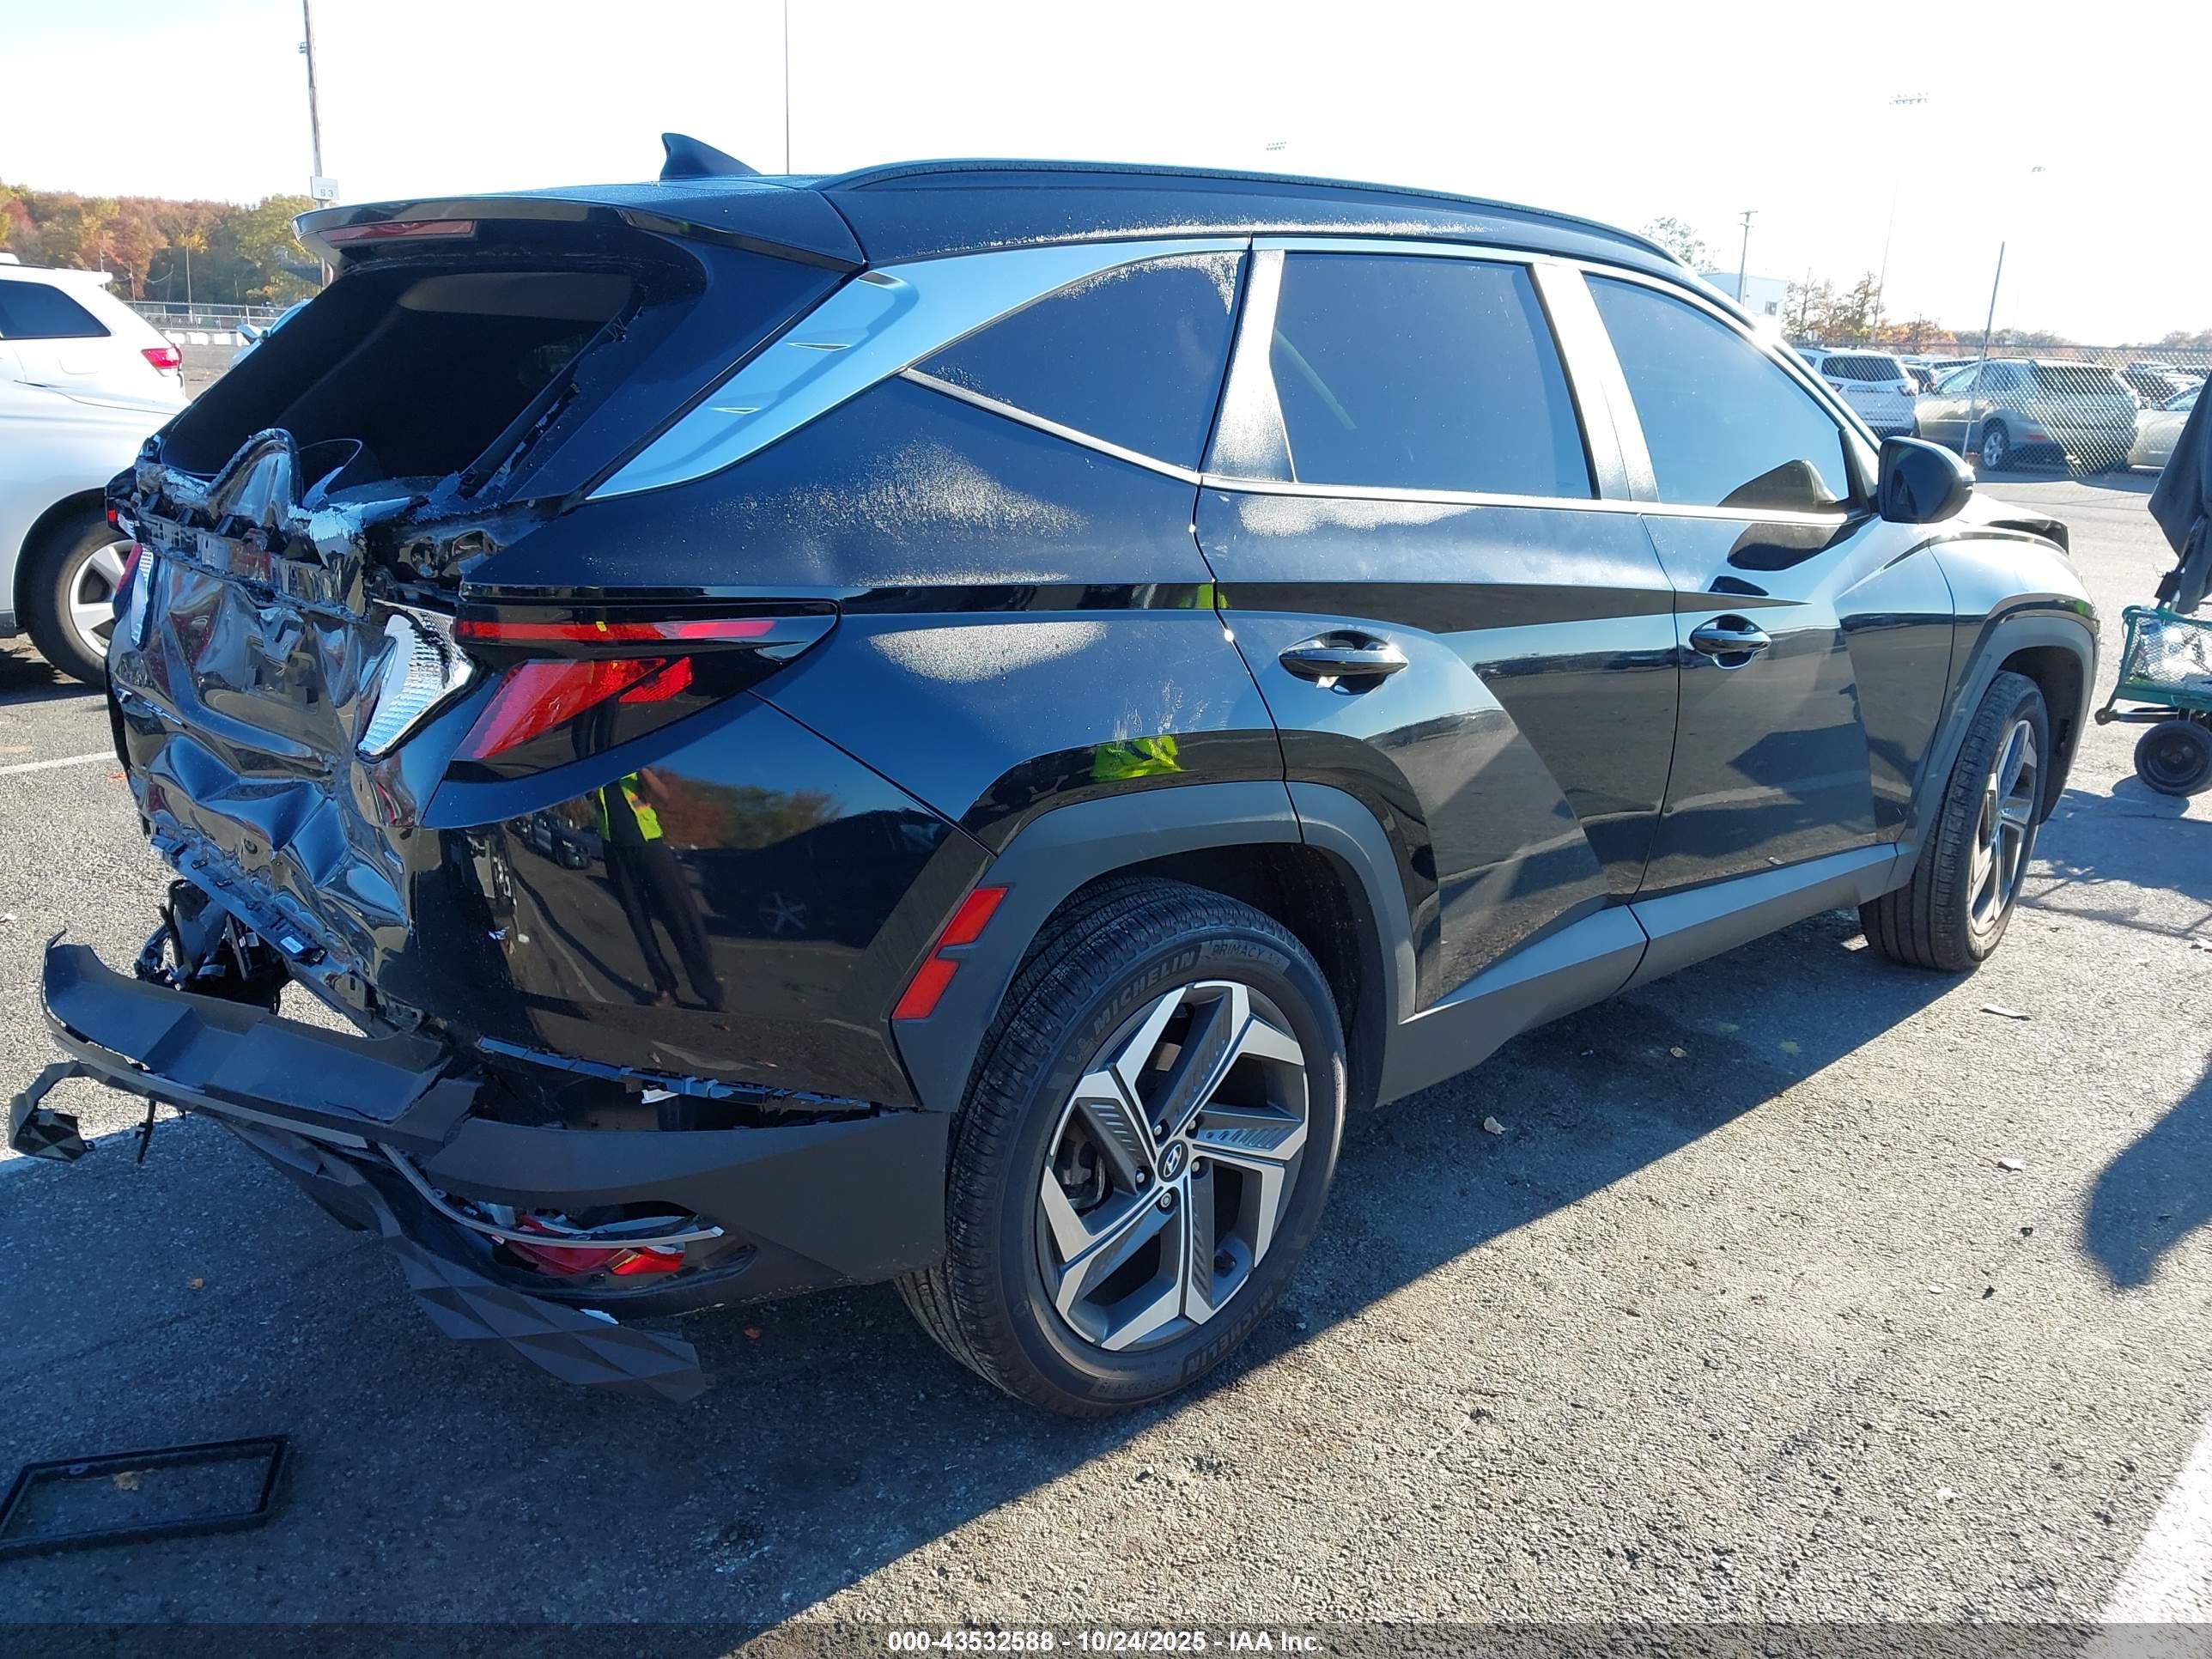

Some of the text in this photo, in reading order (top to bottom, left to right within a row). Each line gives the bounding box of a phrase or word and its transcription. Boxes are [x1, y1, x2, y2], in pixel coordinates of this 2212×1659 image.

[1093, 950, 1196, 1036] MICHELIN
[1211, 943, 1264, 960] PRIMACY
[1186, 1287, 1275, 1376] MICHELIN
